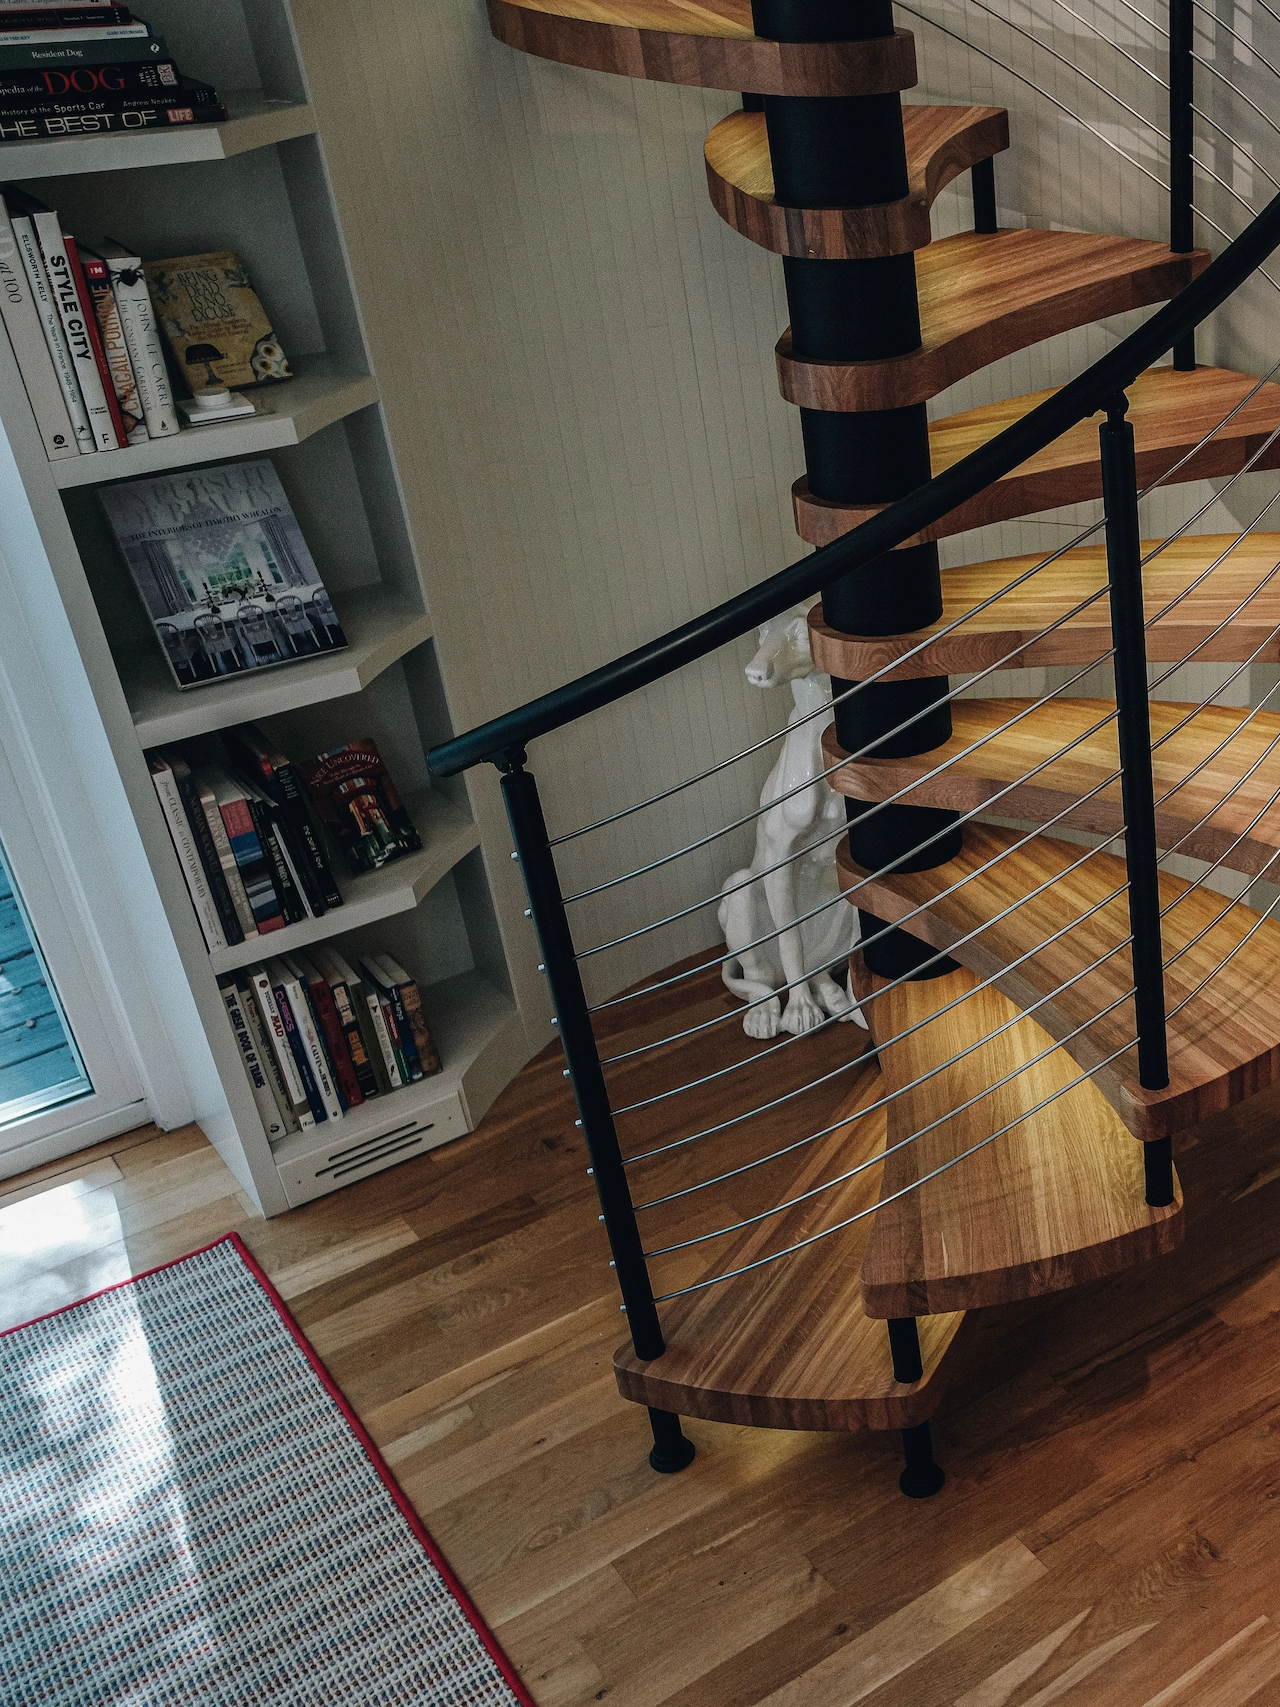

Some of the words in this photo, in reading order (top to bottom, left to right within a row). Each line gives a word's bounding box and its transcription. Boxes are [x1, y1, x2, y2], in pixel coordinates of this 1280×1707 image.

[32, 50, 65, 59] Resident
[66, 49, 83, 58] Dog
[0, 105, 28, 116] History
[30, 105, 38, 114] of
[39, 104, 51, 113] the
[53, 103, 84, 114] Sports
[87, 101, 105, 111] Car
[0, 119, 39, 138] HE
[45, 113, 115, 134] BEST
[121, 110, 157, 127] OF
[168, 109, 194, 122] LIFE
[22, 235, 39, 278] ELLSWORTH
[37, 281, 47, 301] KELLY
[177, 268, 218, 287] BEING
[185, 282, 220, 299] DEAD
[51, 256, 78, 312] STYLE
[68, 319, 91, 359] CITY
[117, 297, 130, 315] THE
[190, 296, 204, 310] IS
[204, 293, 226, 307] NO
[191, 304, 236, 322] EXCUSE
[132, 298, 154, 332] JOHN
[145, 343, 158, 358] LE
[121, 318, 143, 363] CONSTANT
[115, 352, 135, 413] CHAGALL
[133, 367, 151, 412] GARDENER
[326, 752, 379, 774] UNCOVERED
[225, 994, 237, 1008] THE
[271, 991, 294, 1031] CLASSICS
[230, 1009, 245, 1030] GREAT
[271, 1016, 284, 1037] MAD
[238, 1031, 251, 1049] BOOK
[246, 1051, 256, 1062] OF
[250, 1064, 265, 1088] TRAINS
